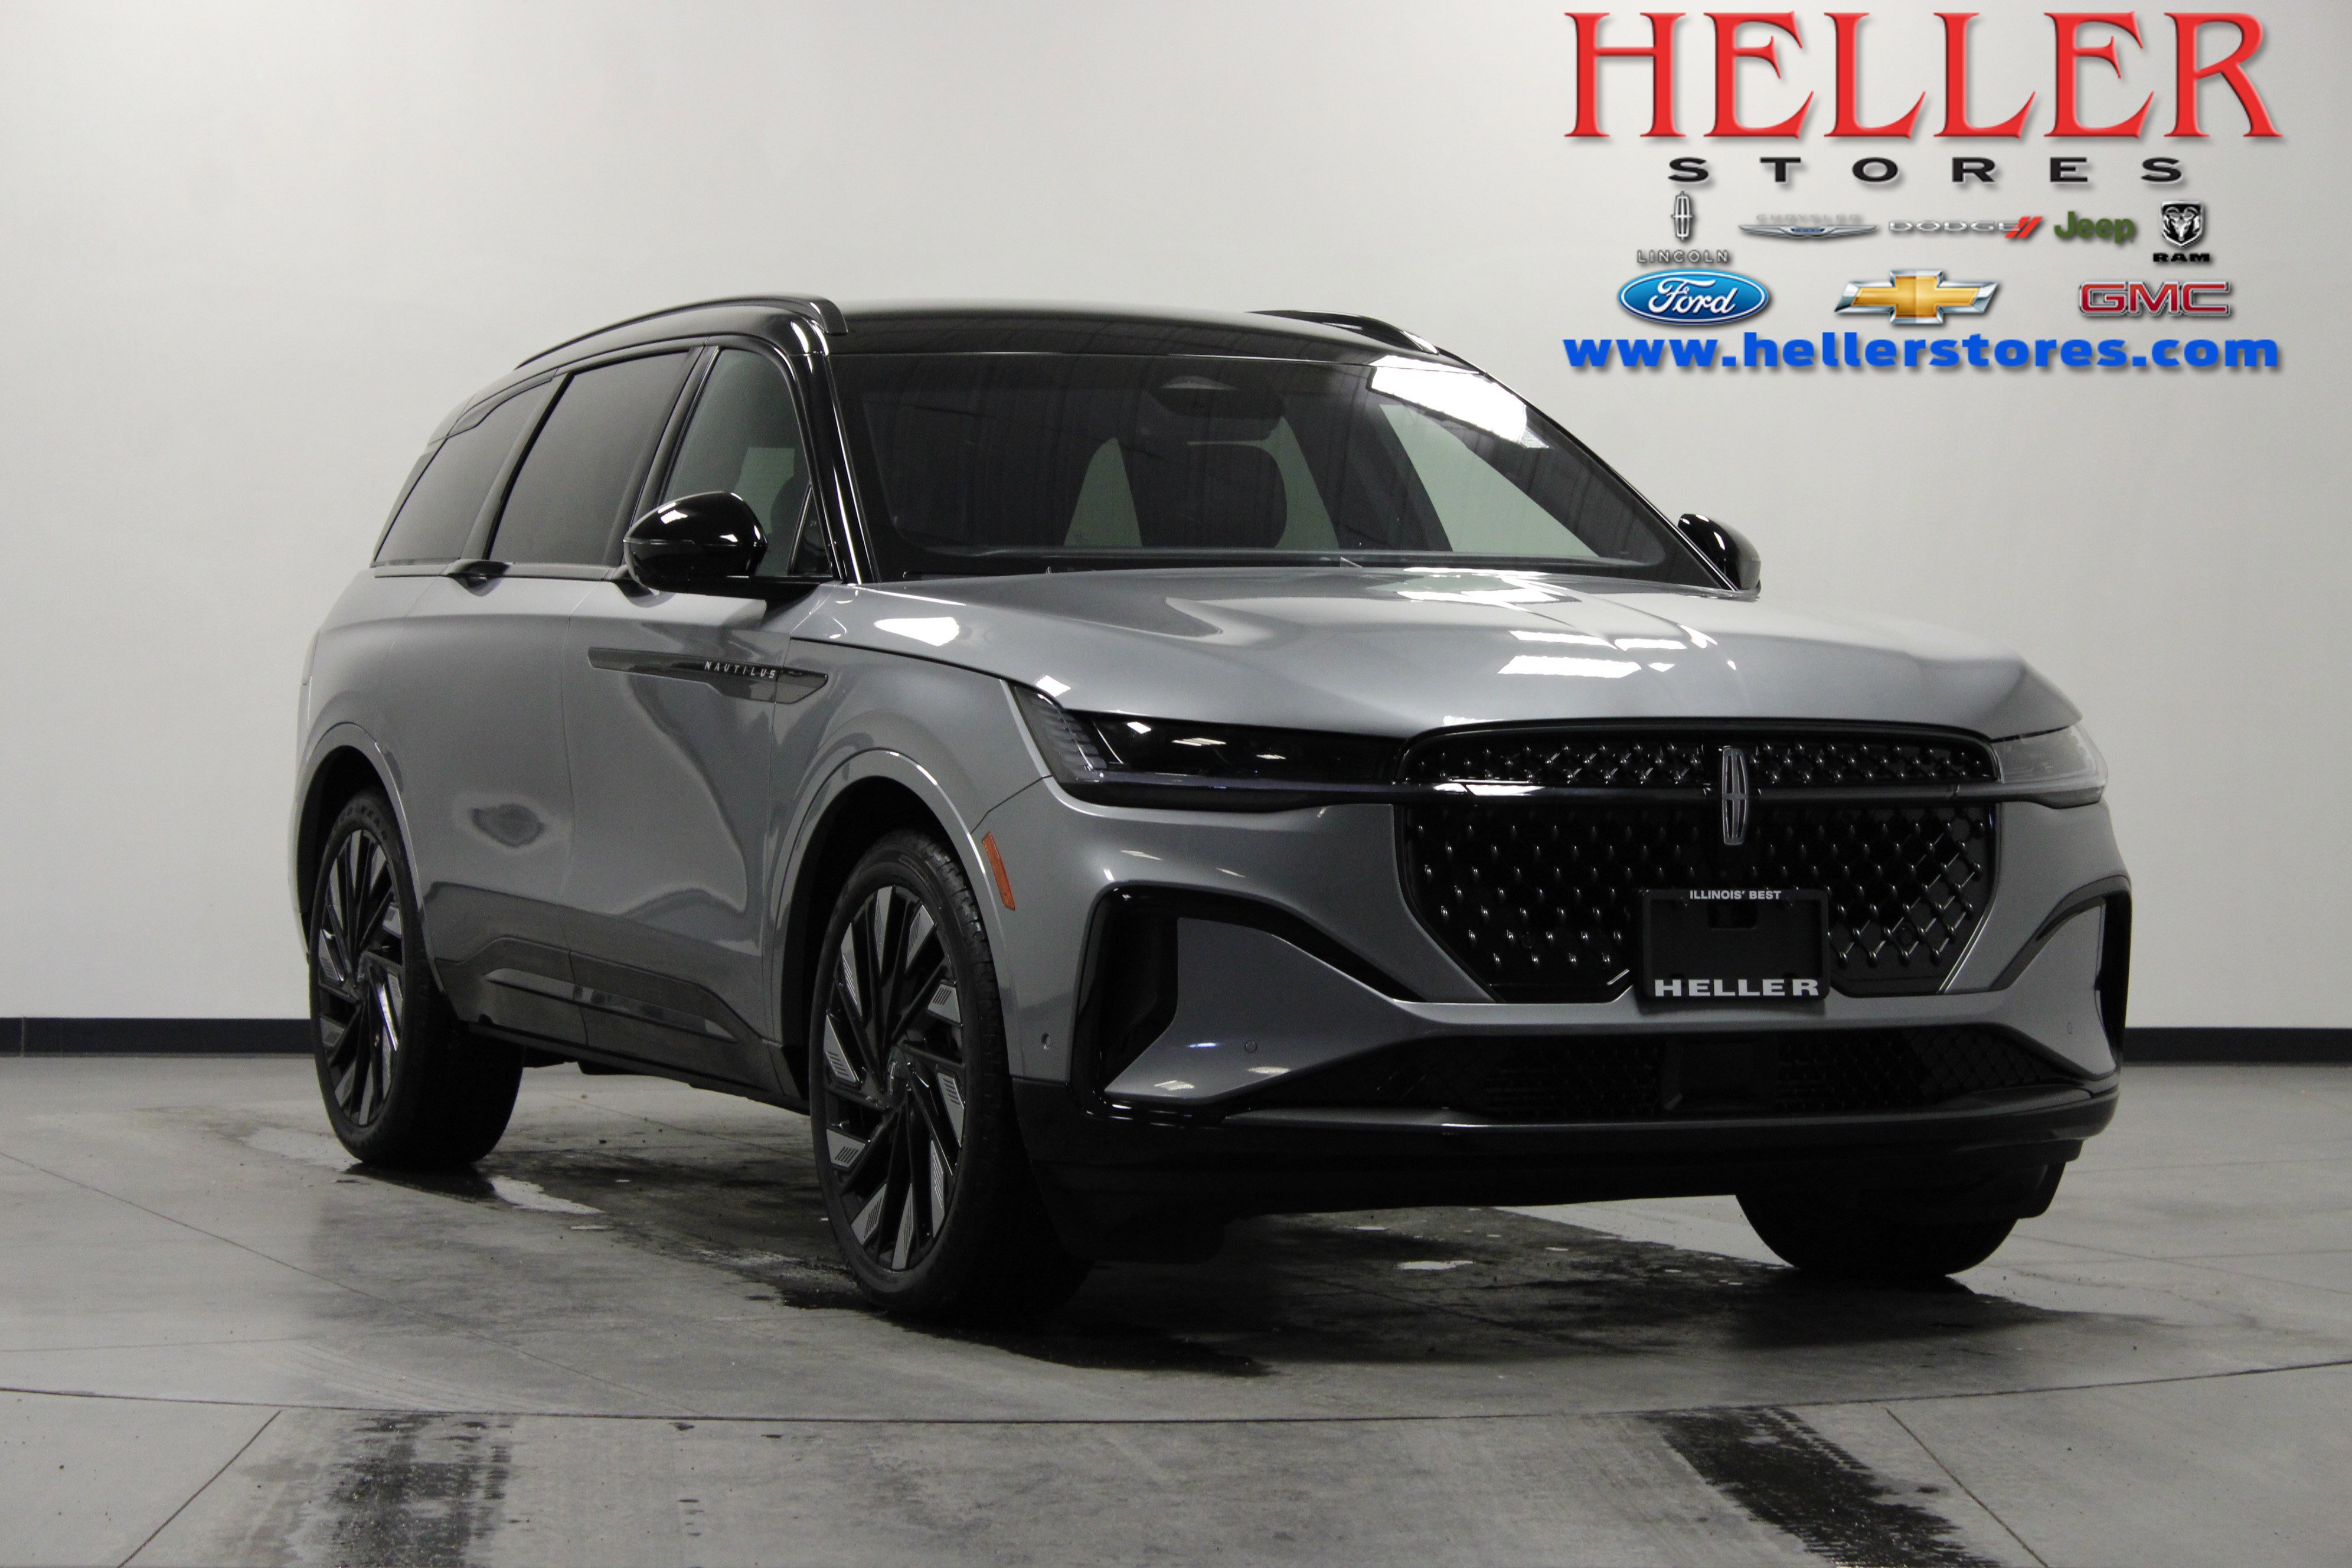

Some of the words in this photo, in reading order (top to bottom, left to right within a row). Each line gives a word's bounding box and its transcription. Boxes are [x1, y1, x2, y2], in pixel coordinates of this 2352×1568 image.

[704, 661, 776, 678] NAUTILUS
[1749, 890, 1782, 900] BEST
[1655, 978, 1819, 997] HELLER
